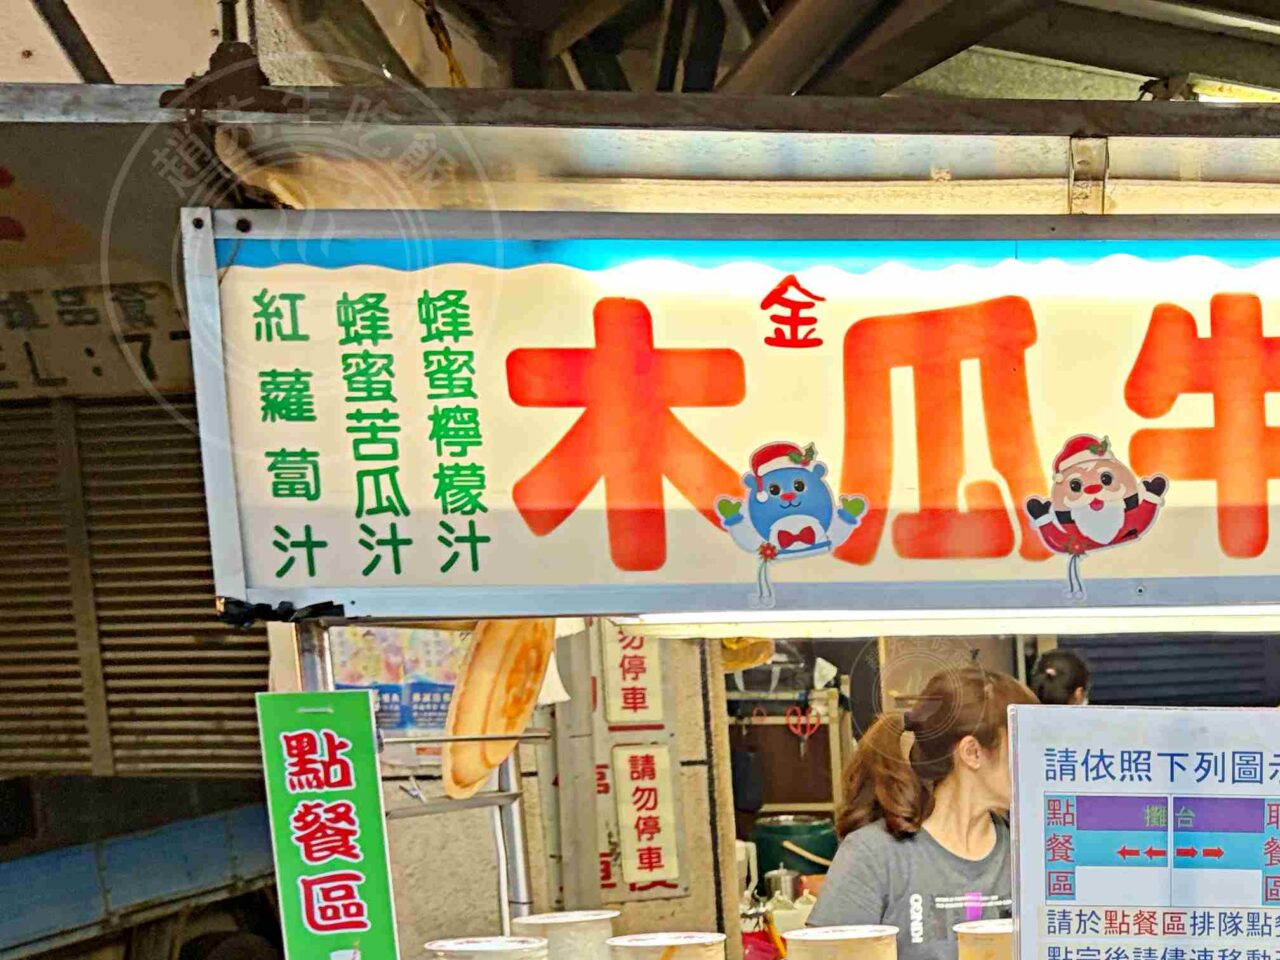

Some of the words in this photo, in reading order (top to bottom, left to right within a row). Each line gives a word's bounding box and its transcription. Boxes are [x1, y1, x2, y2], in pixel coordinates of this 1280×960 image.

[252, 289, 328, 577] 紅蘿蔔汁
[335, 290, 412, 576] 蜂蜜苦瓜汁
[416, 289, 491, 573] 蜂蜜檸檬汁
[280, 730, 371, 934] 點餐區
[628, 754, 665, 873] 請勿停車
[1046, 798, 1076, 897] 點餐區
